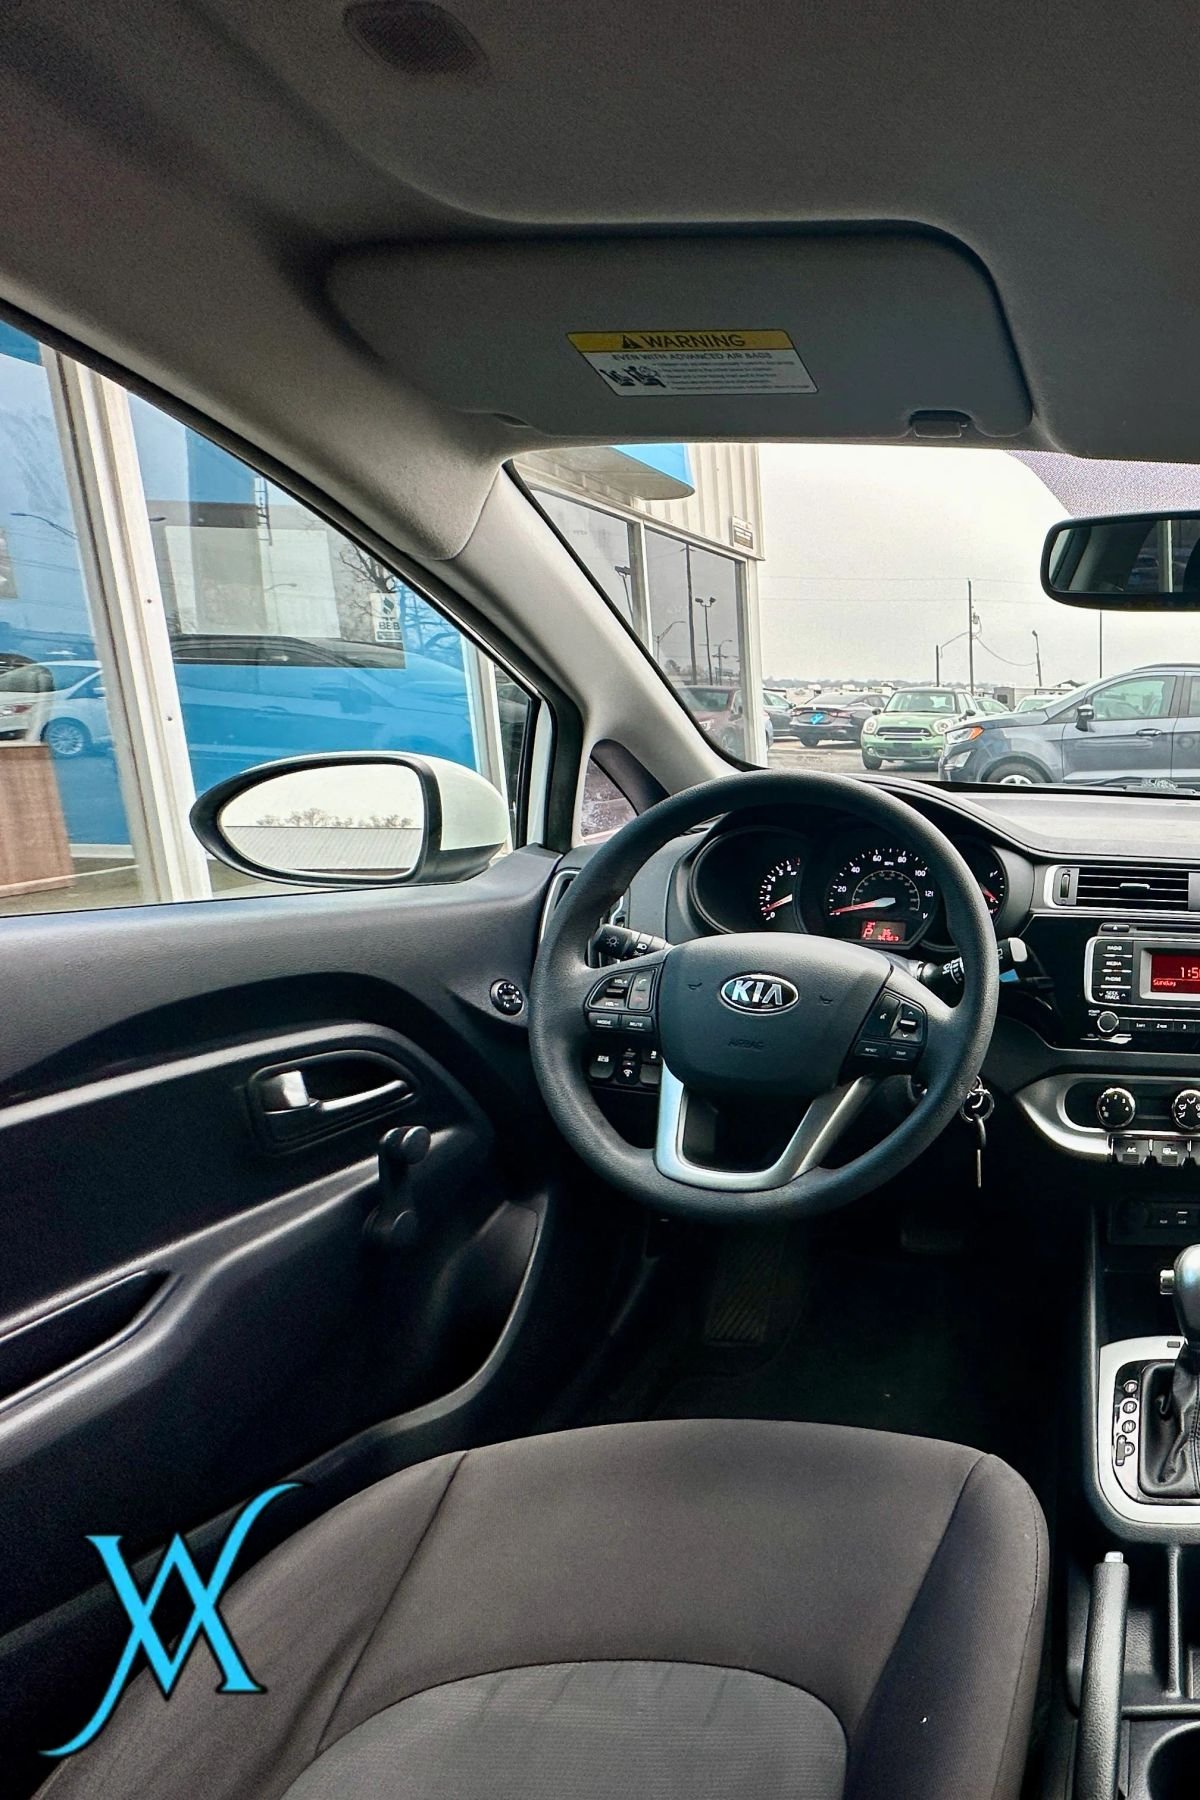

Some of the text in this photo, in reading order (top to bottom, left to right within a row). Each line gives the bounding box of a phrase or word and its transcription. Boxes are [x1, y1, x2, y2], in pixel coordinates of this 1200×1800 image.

[641, 334, 745, 348] WARNING
[612, 351, 772, 361] EVEN WITH ADVANCED AIR BAGS
[1153, 979, 1176, 988] Sunday
[731, 980, 783, 1005] KIA
